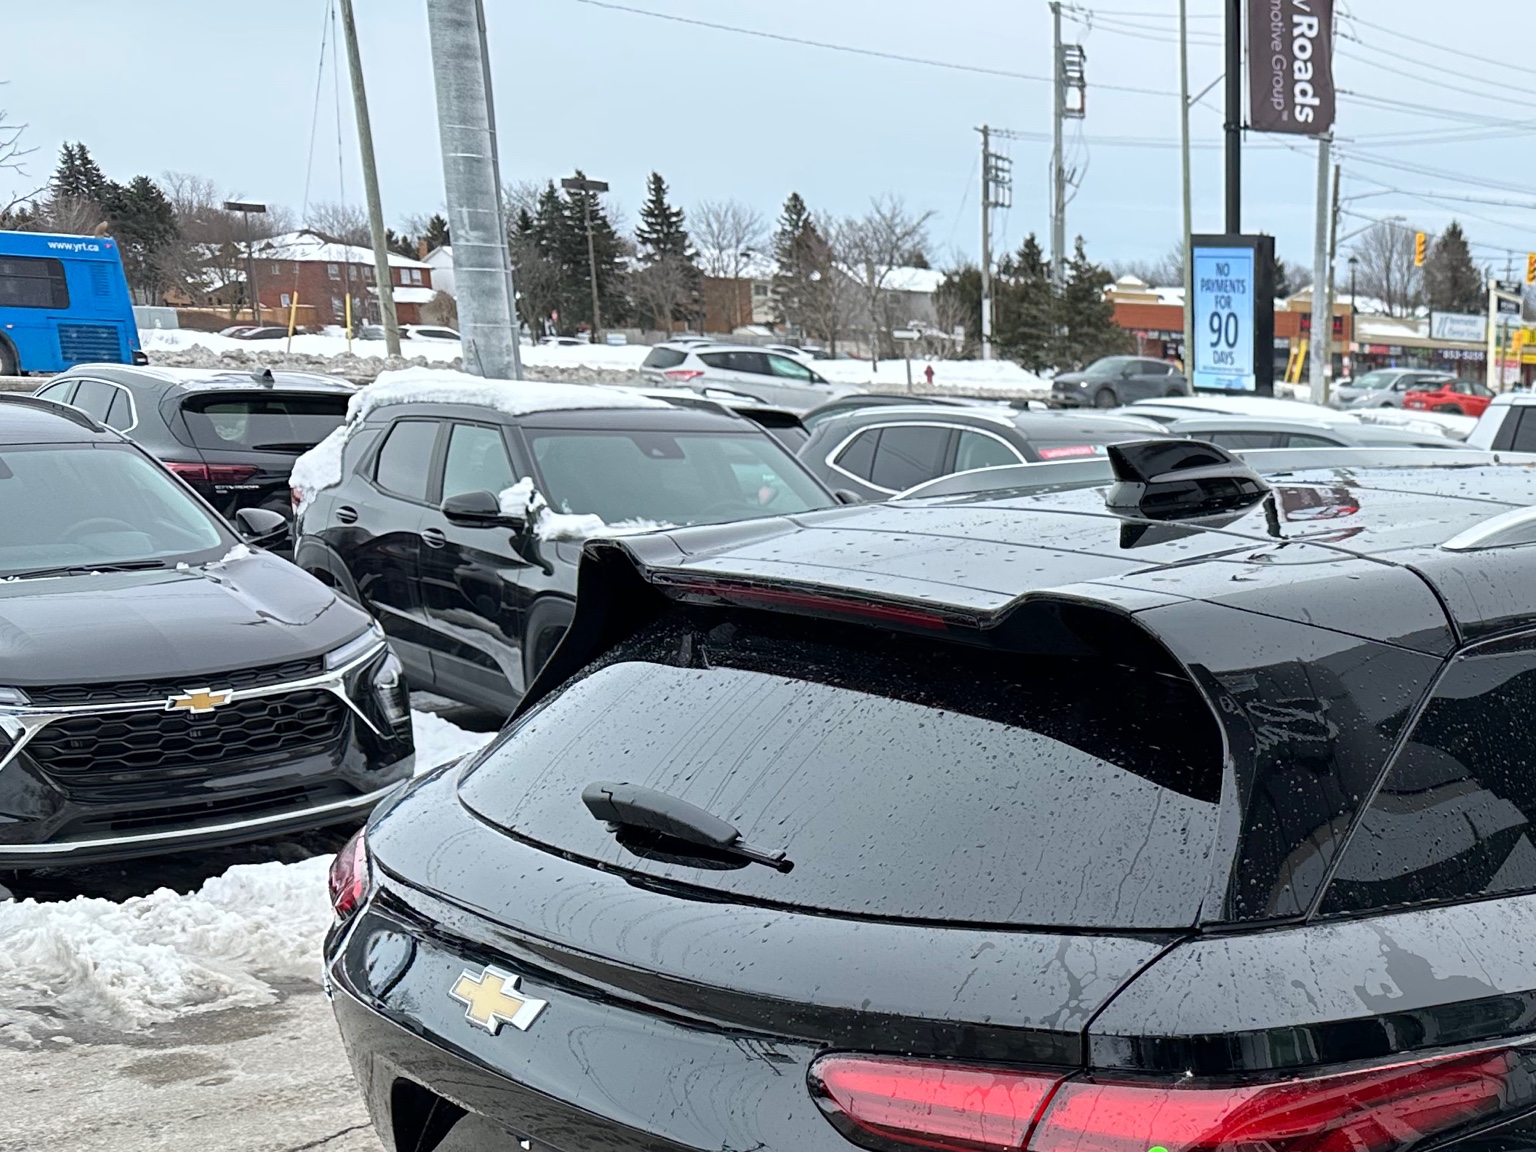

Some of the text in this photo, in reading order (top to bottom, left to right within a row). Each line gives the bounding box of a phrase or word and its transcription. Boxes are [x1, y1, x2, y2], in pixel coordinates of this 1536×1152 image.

[1292, 14, 1320, 123] Roads
[47, 241, 100, 253] www.yrt.ca
[1215, 262, 1231, 278] NO
[1200, 278, 1247, 295] PAYMENTS
[1214, 294, 1232, 311] FOR
[1208, 310, 1239, 349] 90
[1212, 350, 1235, 366] DAYS
